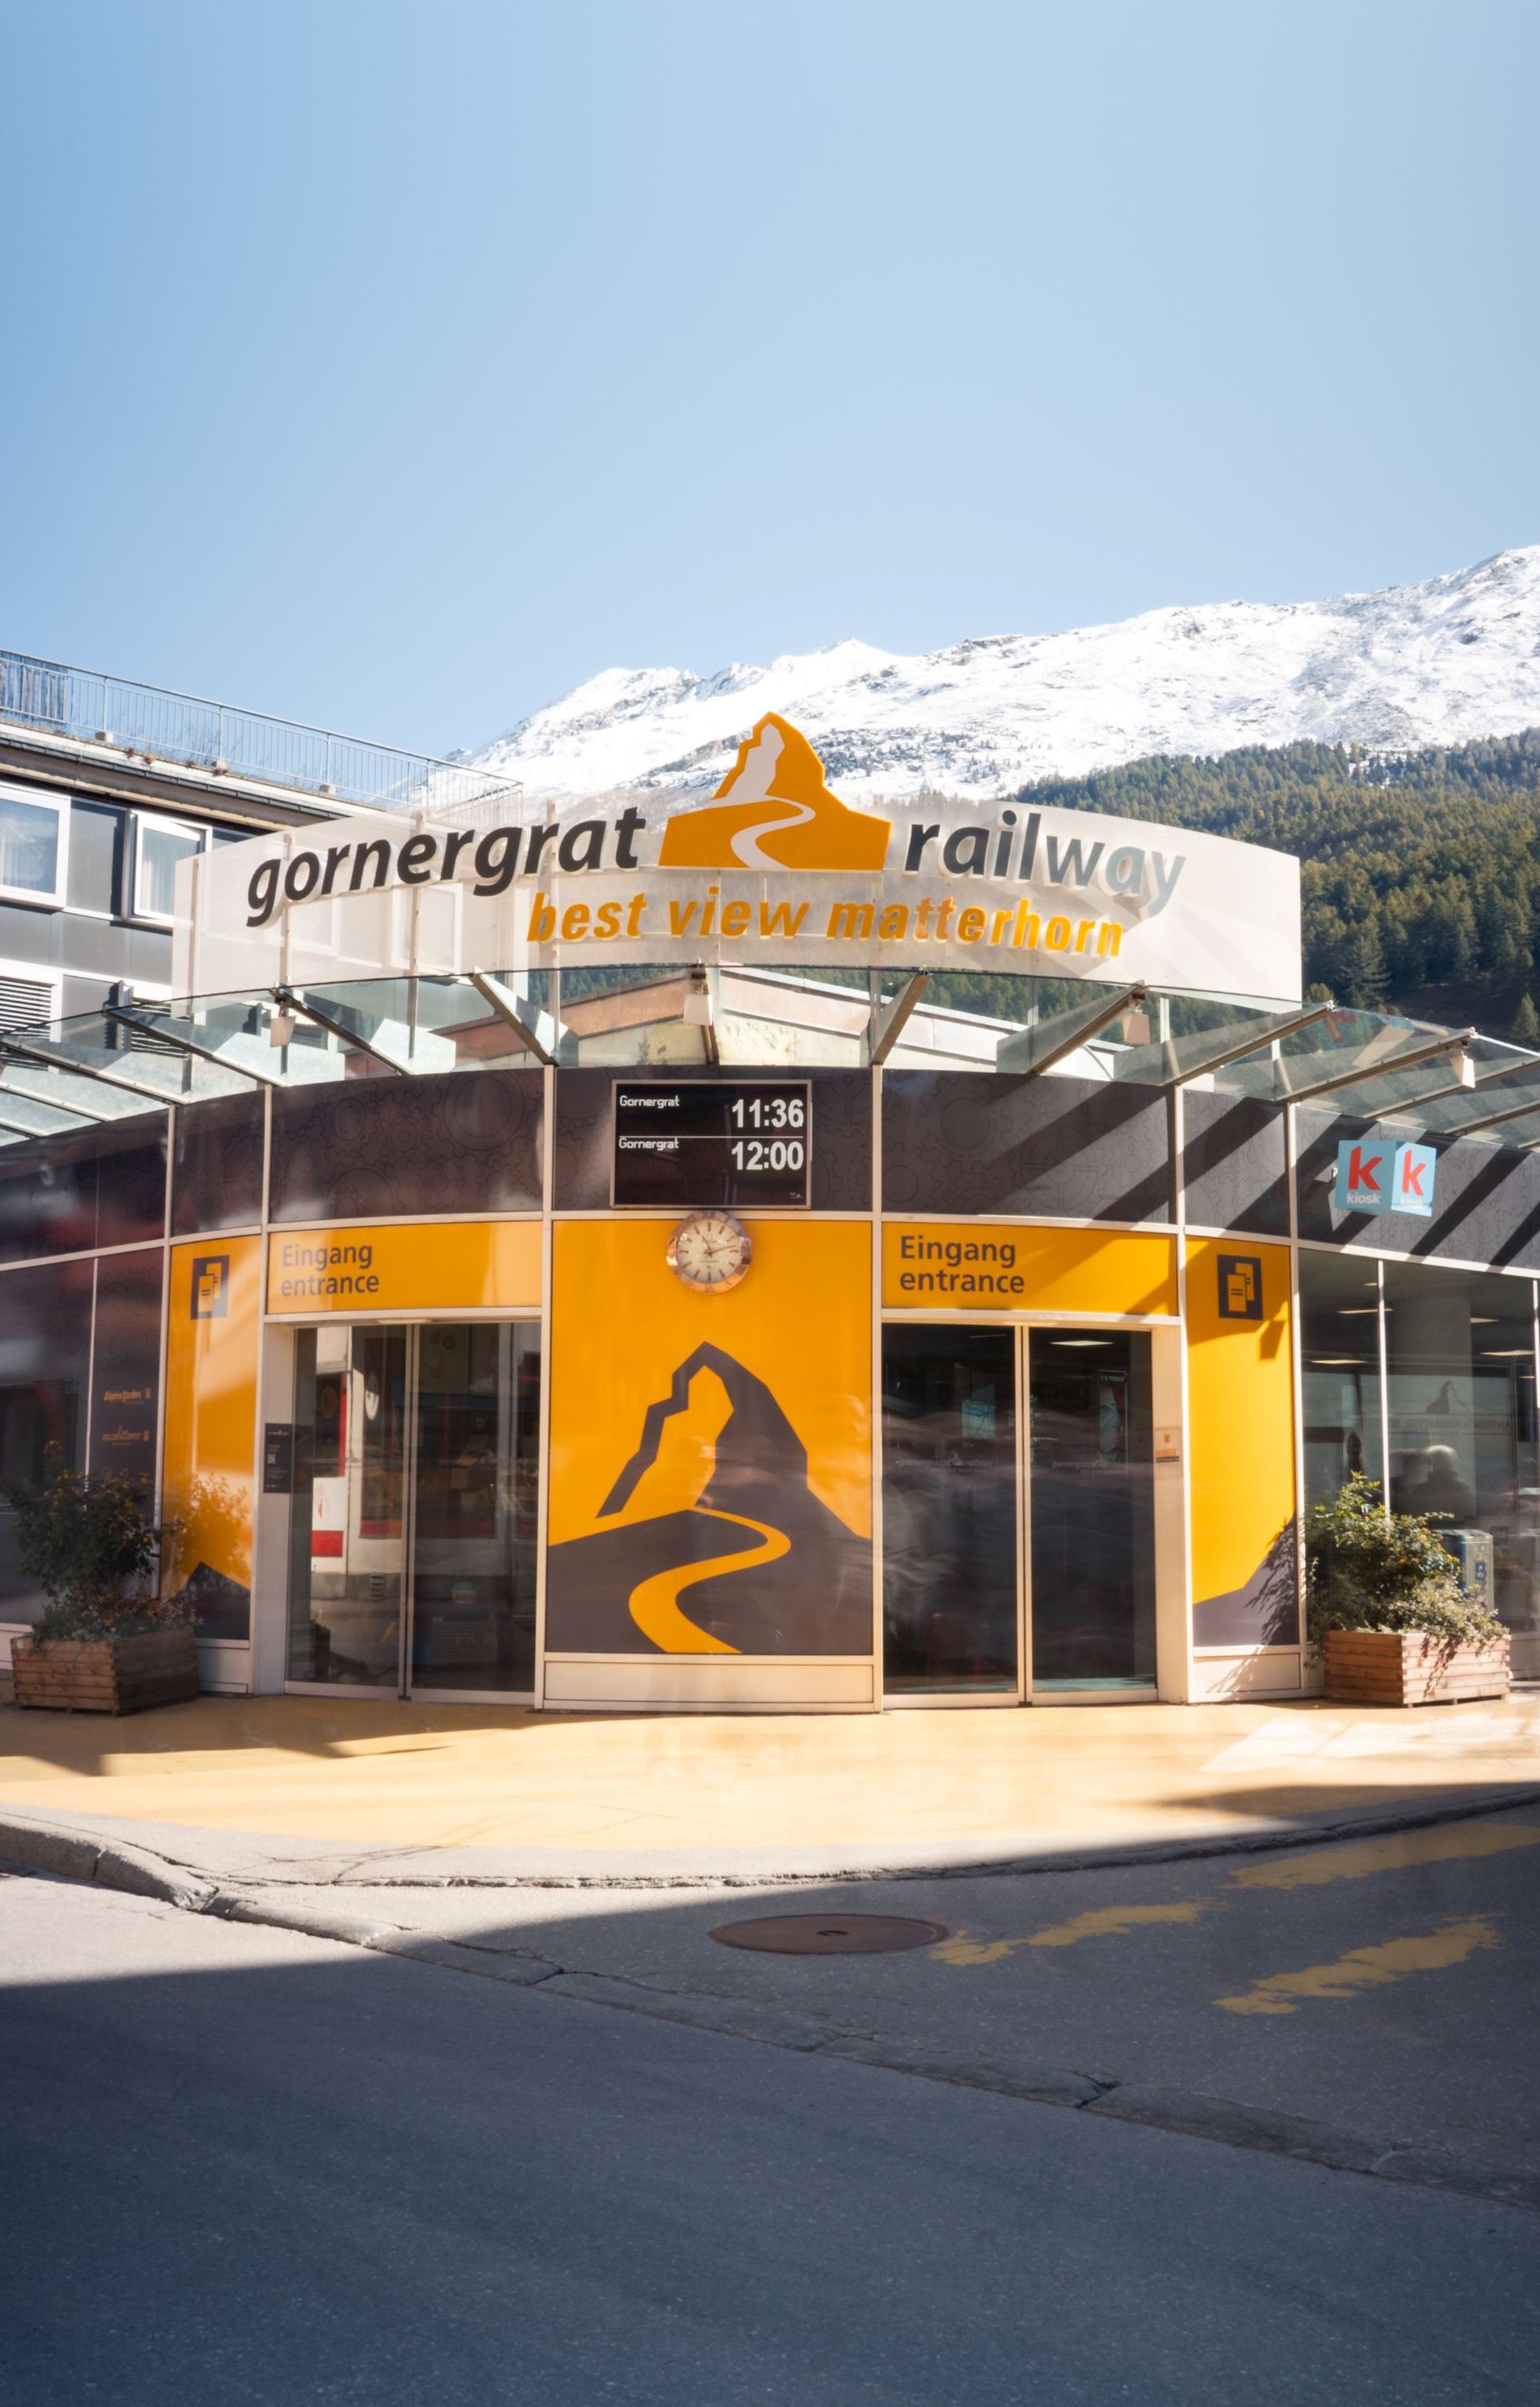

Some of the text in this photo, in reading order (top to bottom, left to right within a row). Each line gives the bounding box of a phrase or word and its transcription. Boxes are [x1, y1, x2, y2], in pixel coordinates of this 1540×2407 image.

[246, 806, 1185, 927] gornergrat railway
[528, 887, 1125, 958] best view matterhorn
[619, 1095, 804, 1128] Gornergrat 11:36
[618, 1138, 804, 1171] Gornergrat 12:00
[1348, 1146, 1383, 1190] k
[1402, 1150, 1426, 1196] k
[1347, 1192, 1381, 1204] kiosk
[282, 1244, 373, 1271] Eingang
[900, 1235, 1016, 1268] Eingang
[282, 1274, 379, 1297] entrance
[899, 1269, 1024, 1293] entrance
